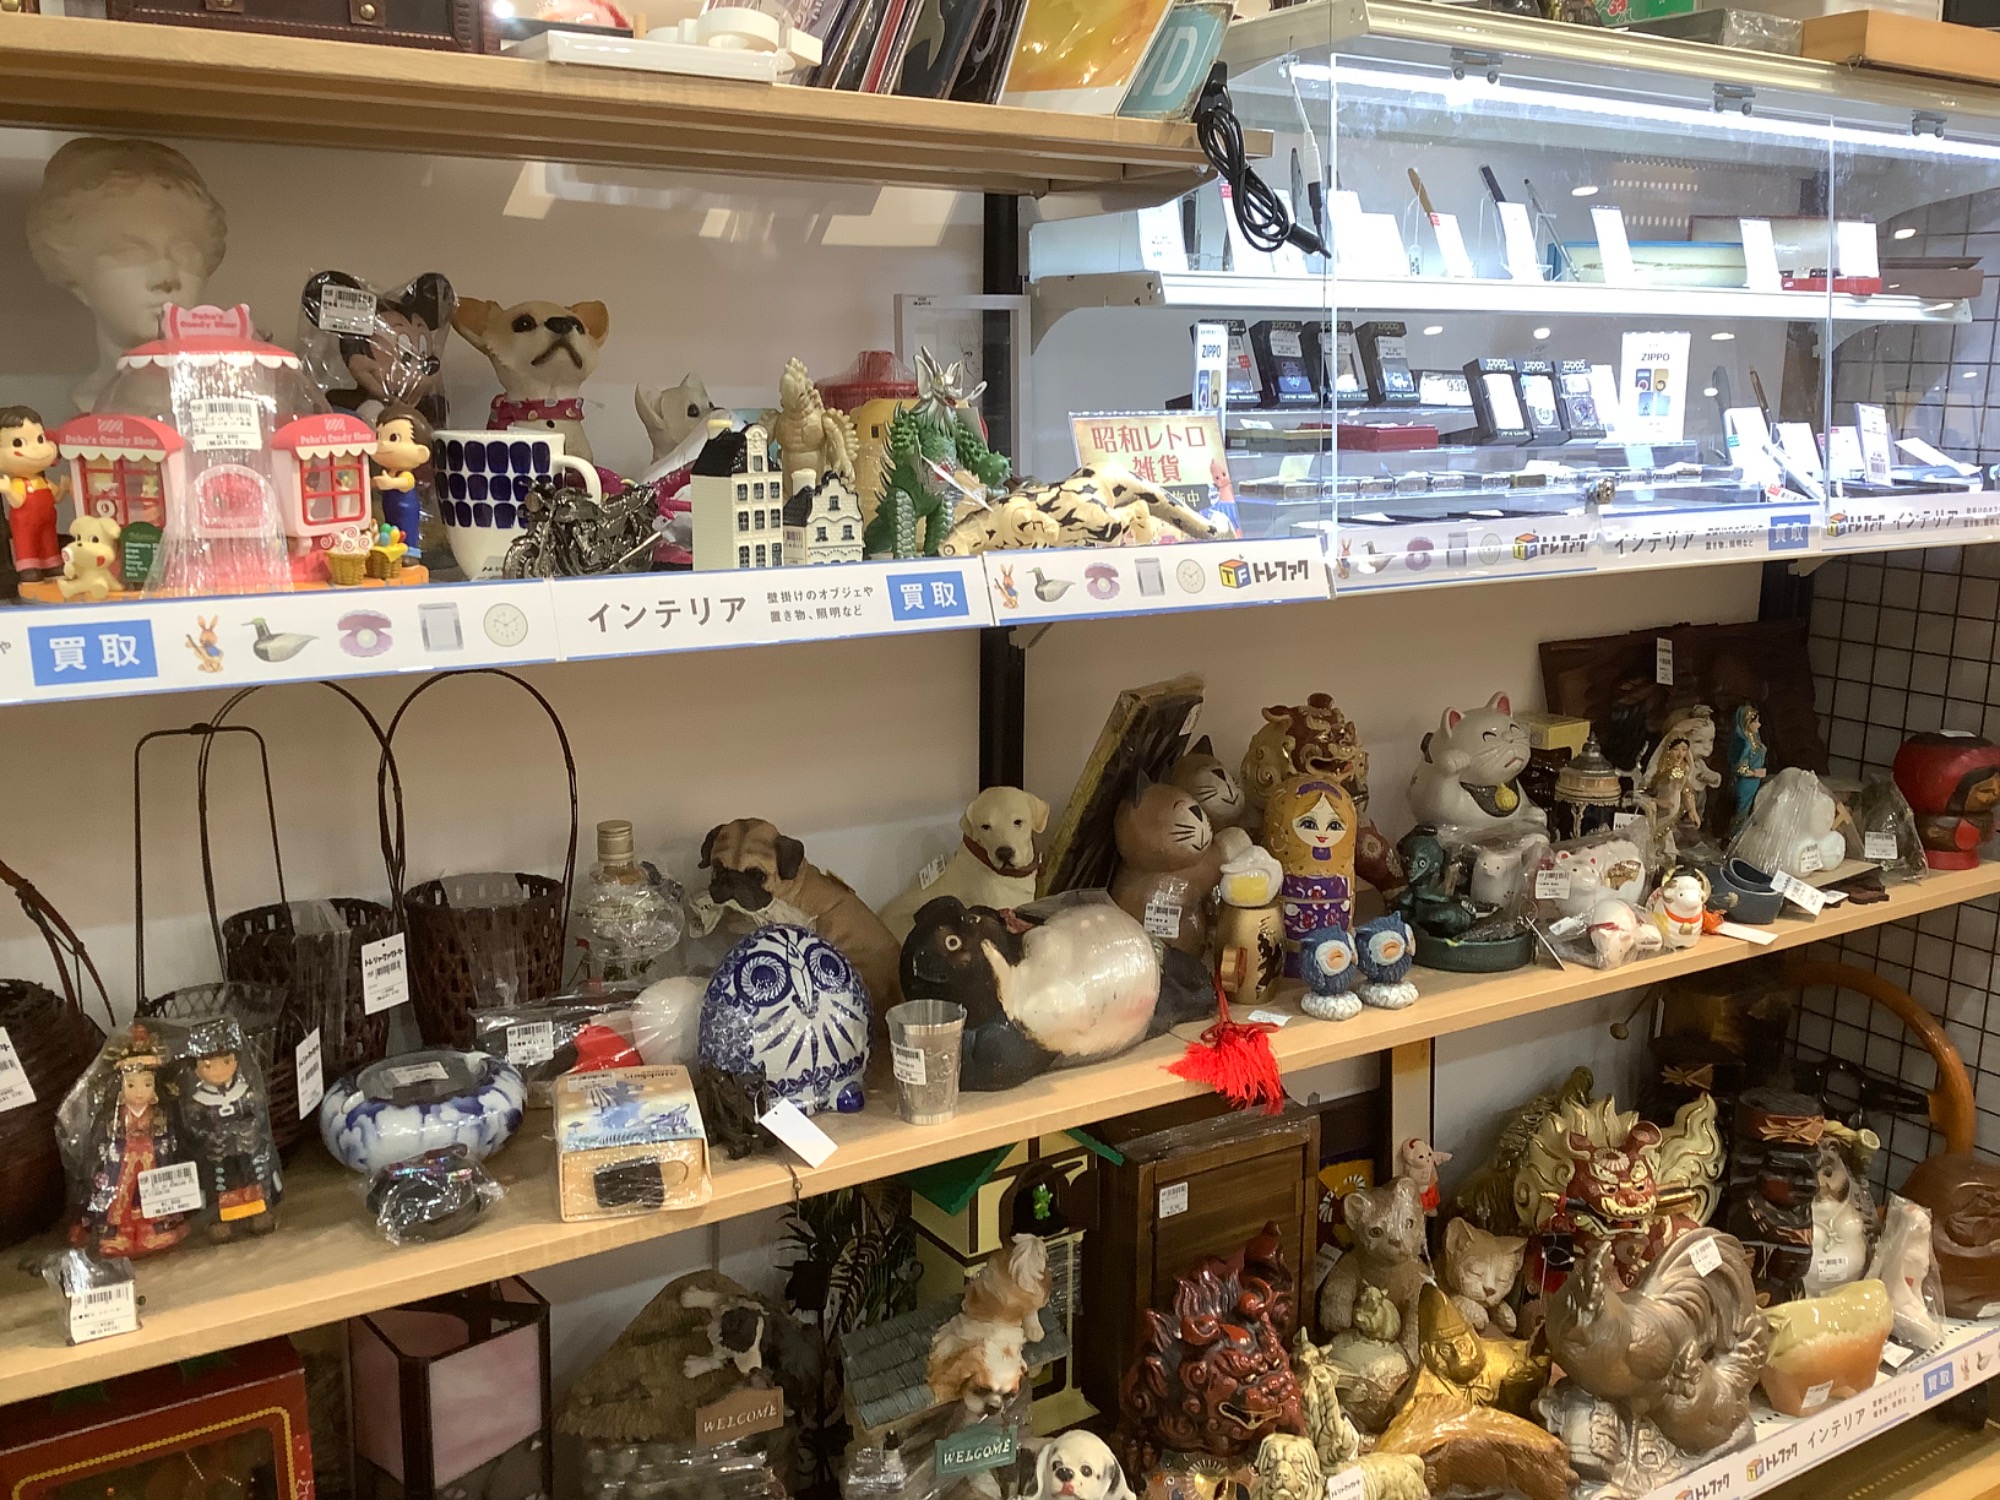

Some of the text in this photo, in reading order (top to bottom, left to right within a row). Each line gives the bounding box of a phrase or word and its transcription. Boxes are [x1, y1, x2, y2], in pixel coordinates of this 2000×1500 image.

[1201, 344, 1221, 358] ZIPPO
[1641, 353, 1670, 361] ZIPPO
[100, 435, 131, 446] Candy
[133, 436, 158, 447] Shop
[328, 433, 352, 443] Candy
[354, 432, 372, 441] Shop
[1091, 424, 1206, 453] 昭和レトロ
[1132, 454, 1183, 484] 雑貨
[1252, 559, 1309, 583] トレファク
[766, 585, 874, 604] 壁掛けのオブジェや
[900, 580, 958, 612] 買取
[587, 596, 747, 633] インテリア
[769, 604, 862, 623] 置き物、照明など
[49, 633, 141, 673] 買取
[704, 1400, 777, 1433] WELCOME
[1808, 1408, 1866, 1449] インテリア
[944, 1438, 1011, 1467] WELCOME
